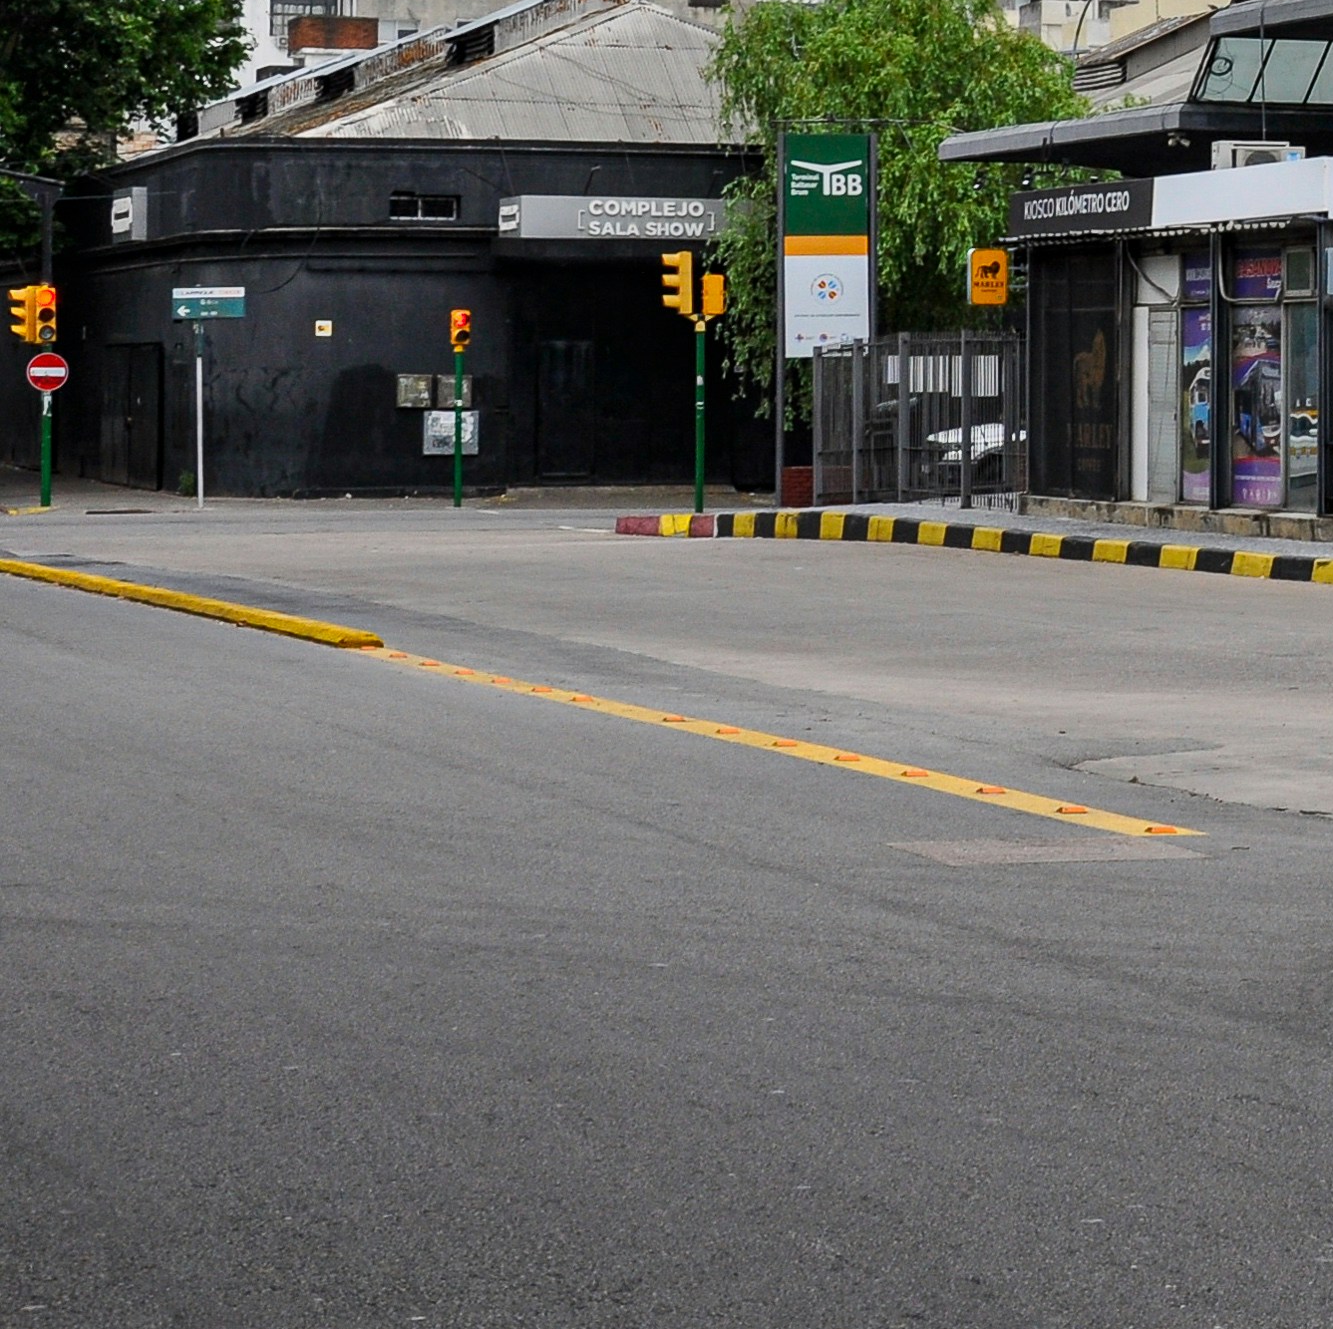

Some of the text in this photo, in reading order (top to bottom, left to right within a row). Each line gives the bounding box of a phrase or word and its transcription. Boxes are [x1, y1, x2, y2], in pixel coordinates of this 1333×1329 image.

[588, 200, 705, 218] COMPLEJO
[1024, 190, 1130, 220] KIOSCO KILÓMETRO CERO
[588, 221, 705, 237] SALA SHOW
